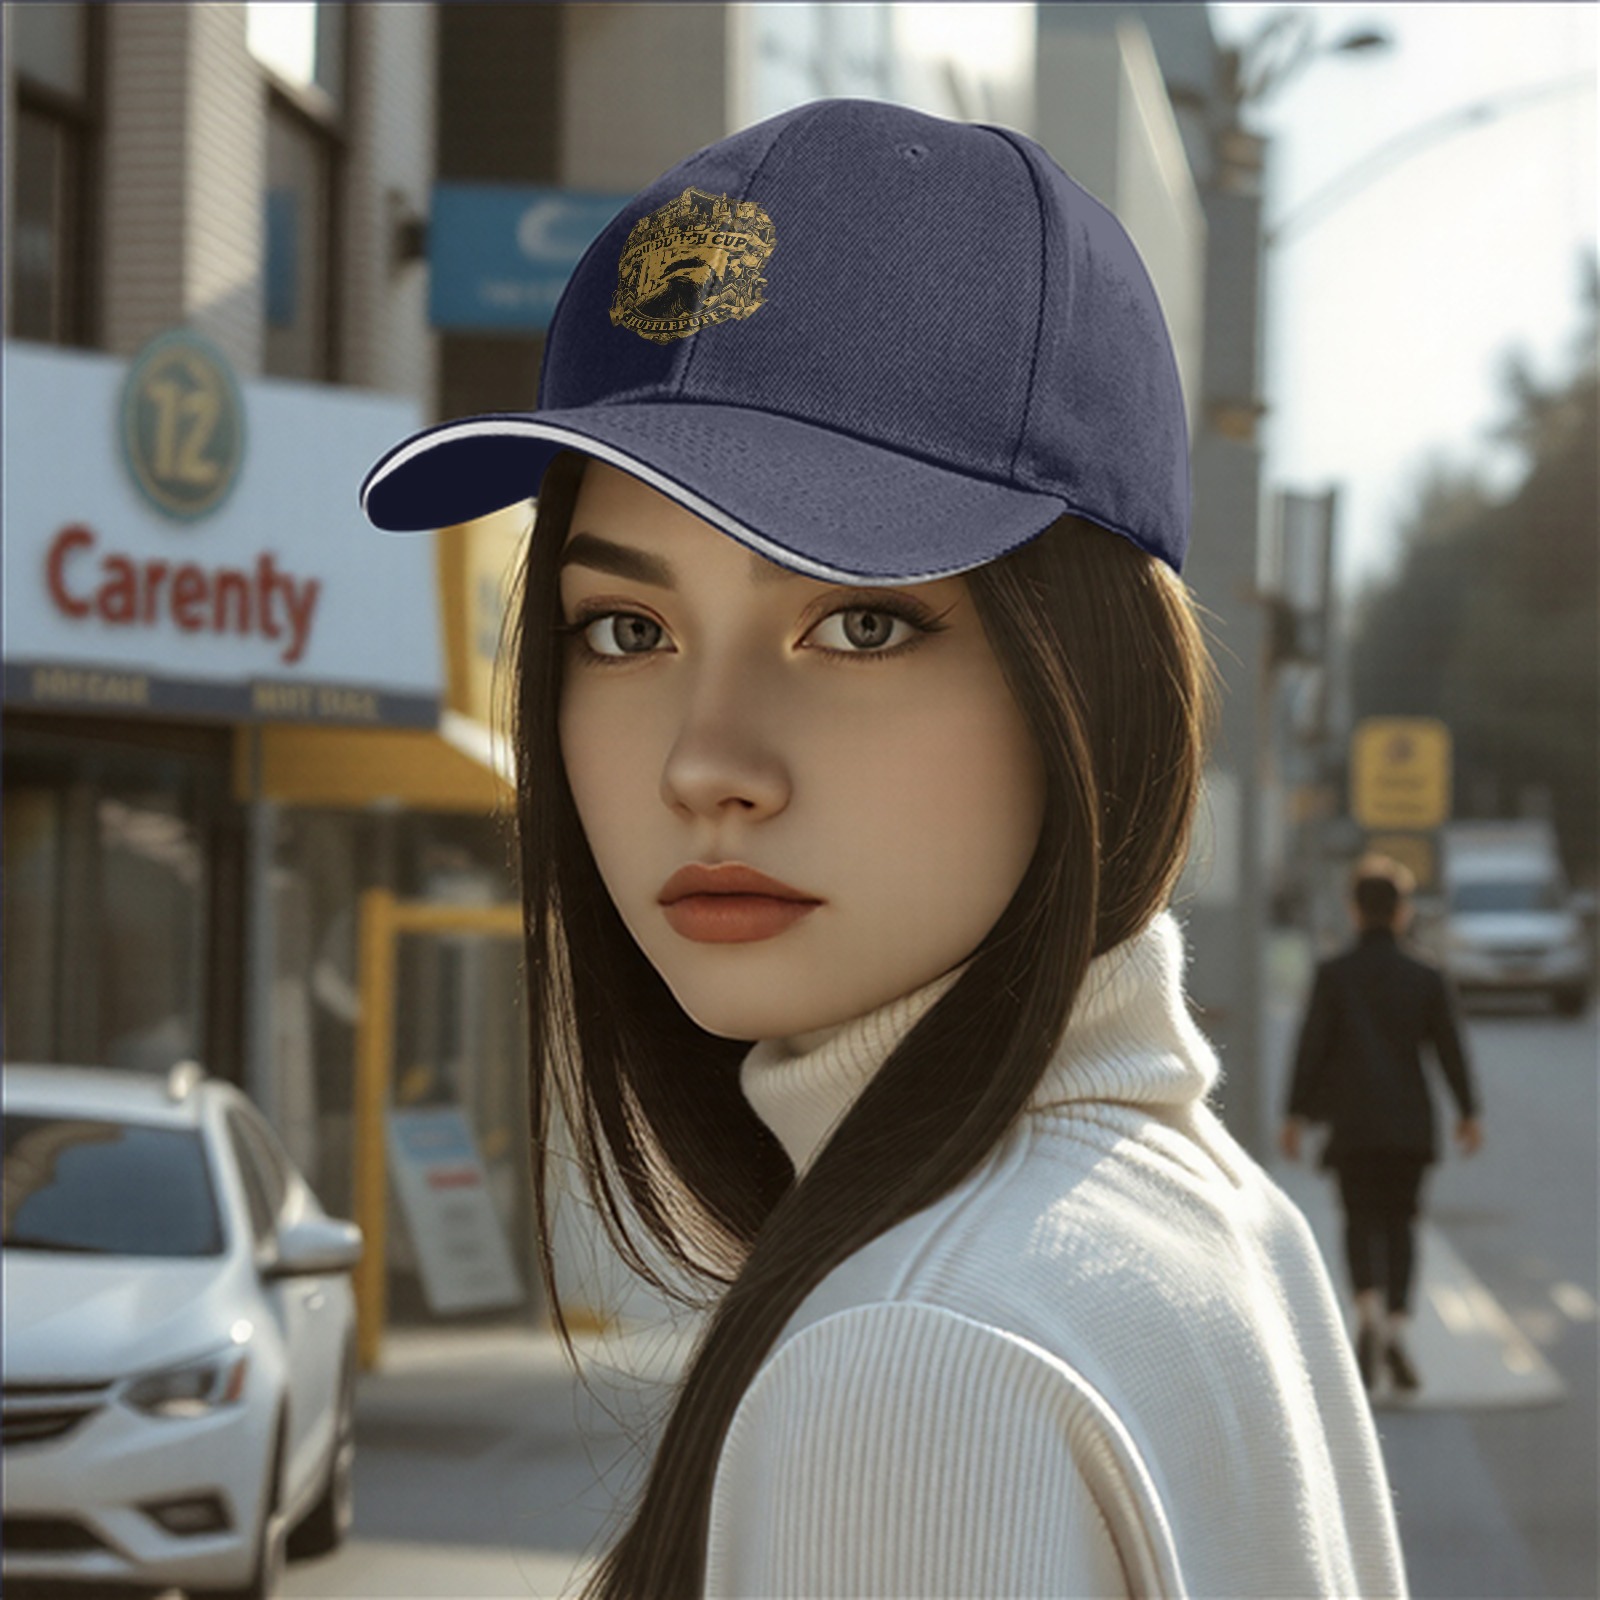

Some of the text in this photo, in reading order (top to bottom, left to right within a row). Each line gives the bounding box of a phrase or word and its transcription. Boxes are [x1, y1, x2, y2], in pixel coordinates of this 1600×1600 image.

[712, 234, 749, 248] CUP
[626, 312, 720, 331] HUFFLEPUFF
[45, 523, 321, 664] Carenty
